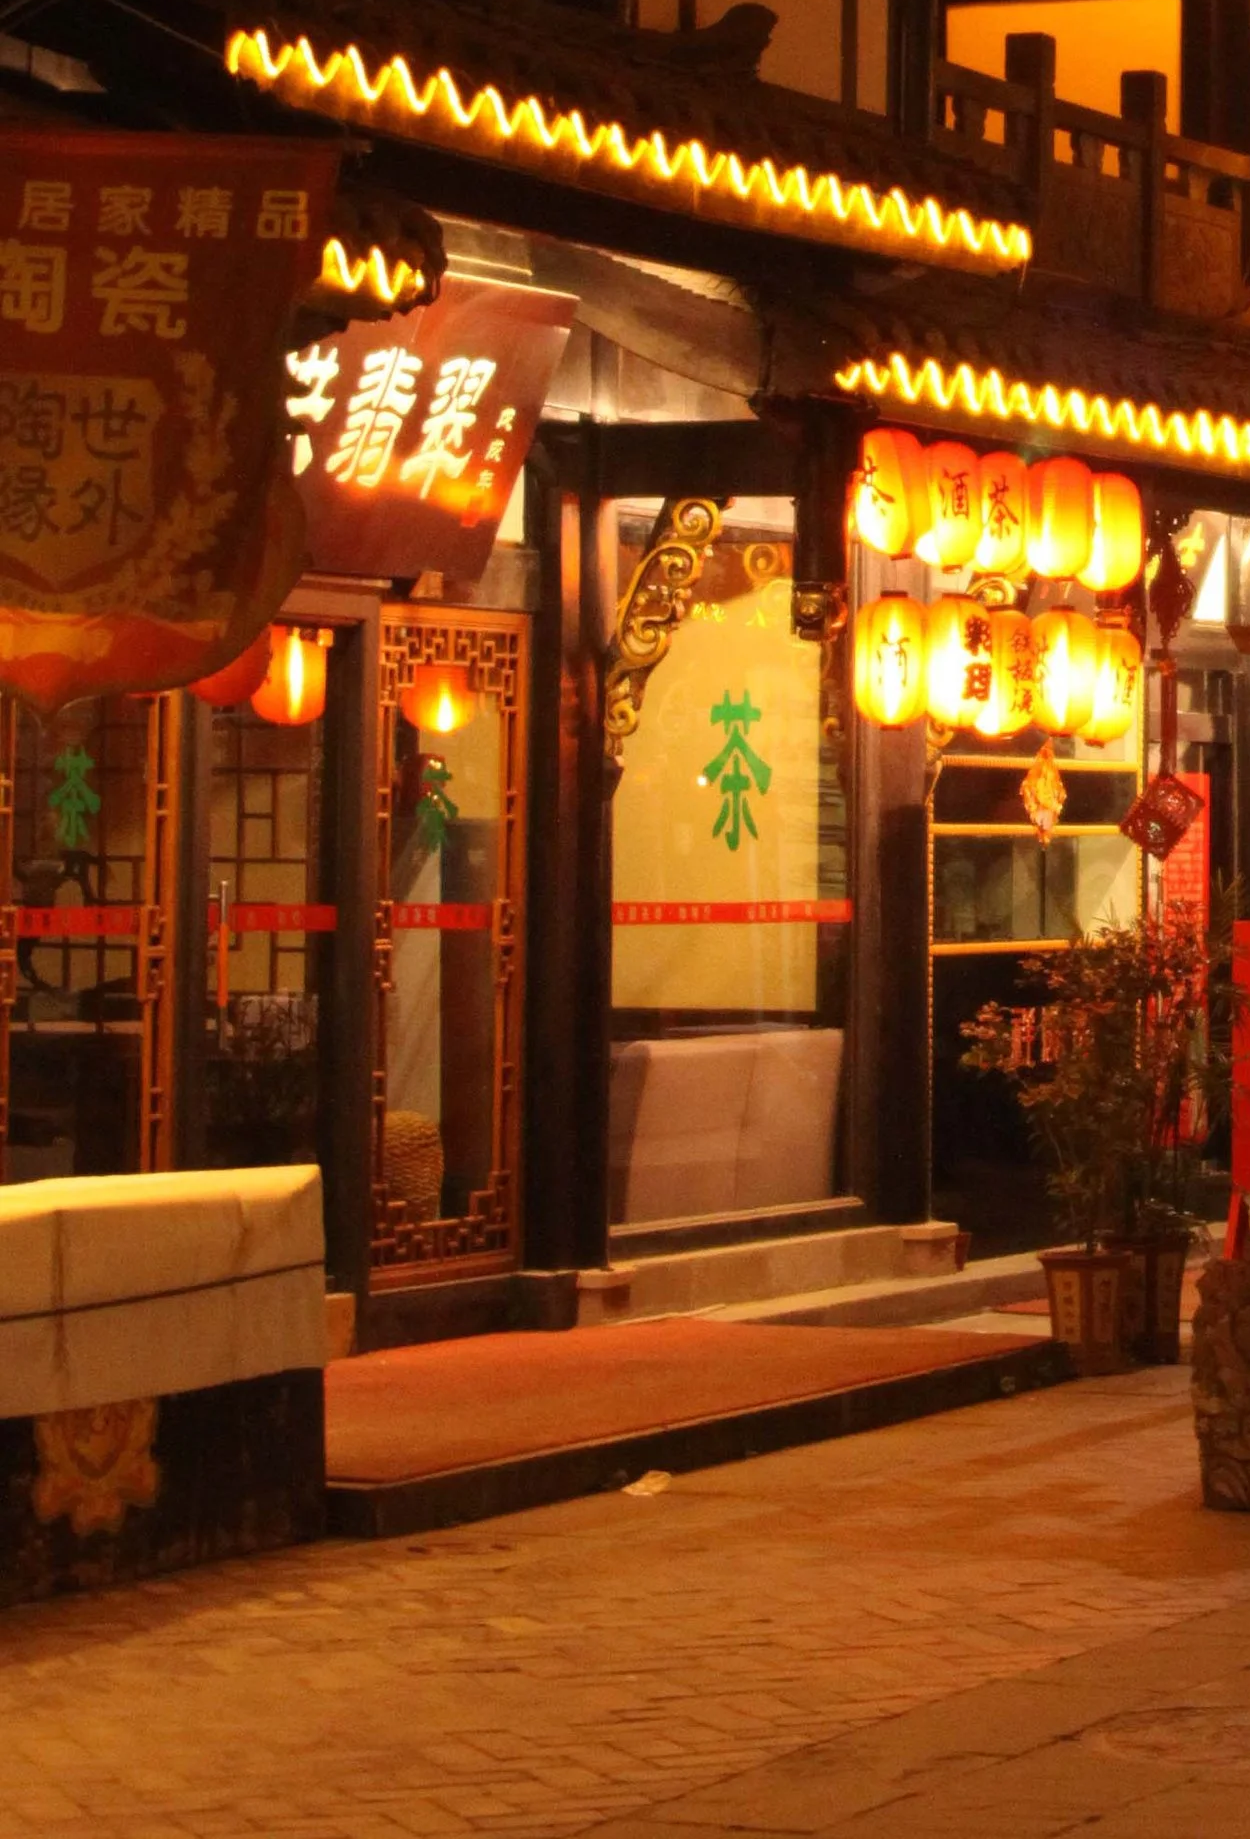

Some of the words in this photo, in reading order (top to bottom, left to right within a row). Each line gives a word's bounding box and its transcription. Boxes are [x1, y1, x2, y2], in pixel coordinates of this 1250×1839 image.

[939, 467, 970, 520] 酒
[982, 474, 1020, 540] 茶
[47, 743, 102, 849] 茶
[702, 688, 773, 852] 茶
